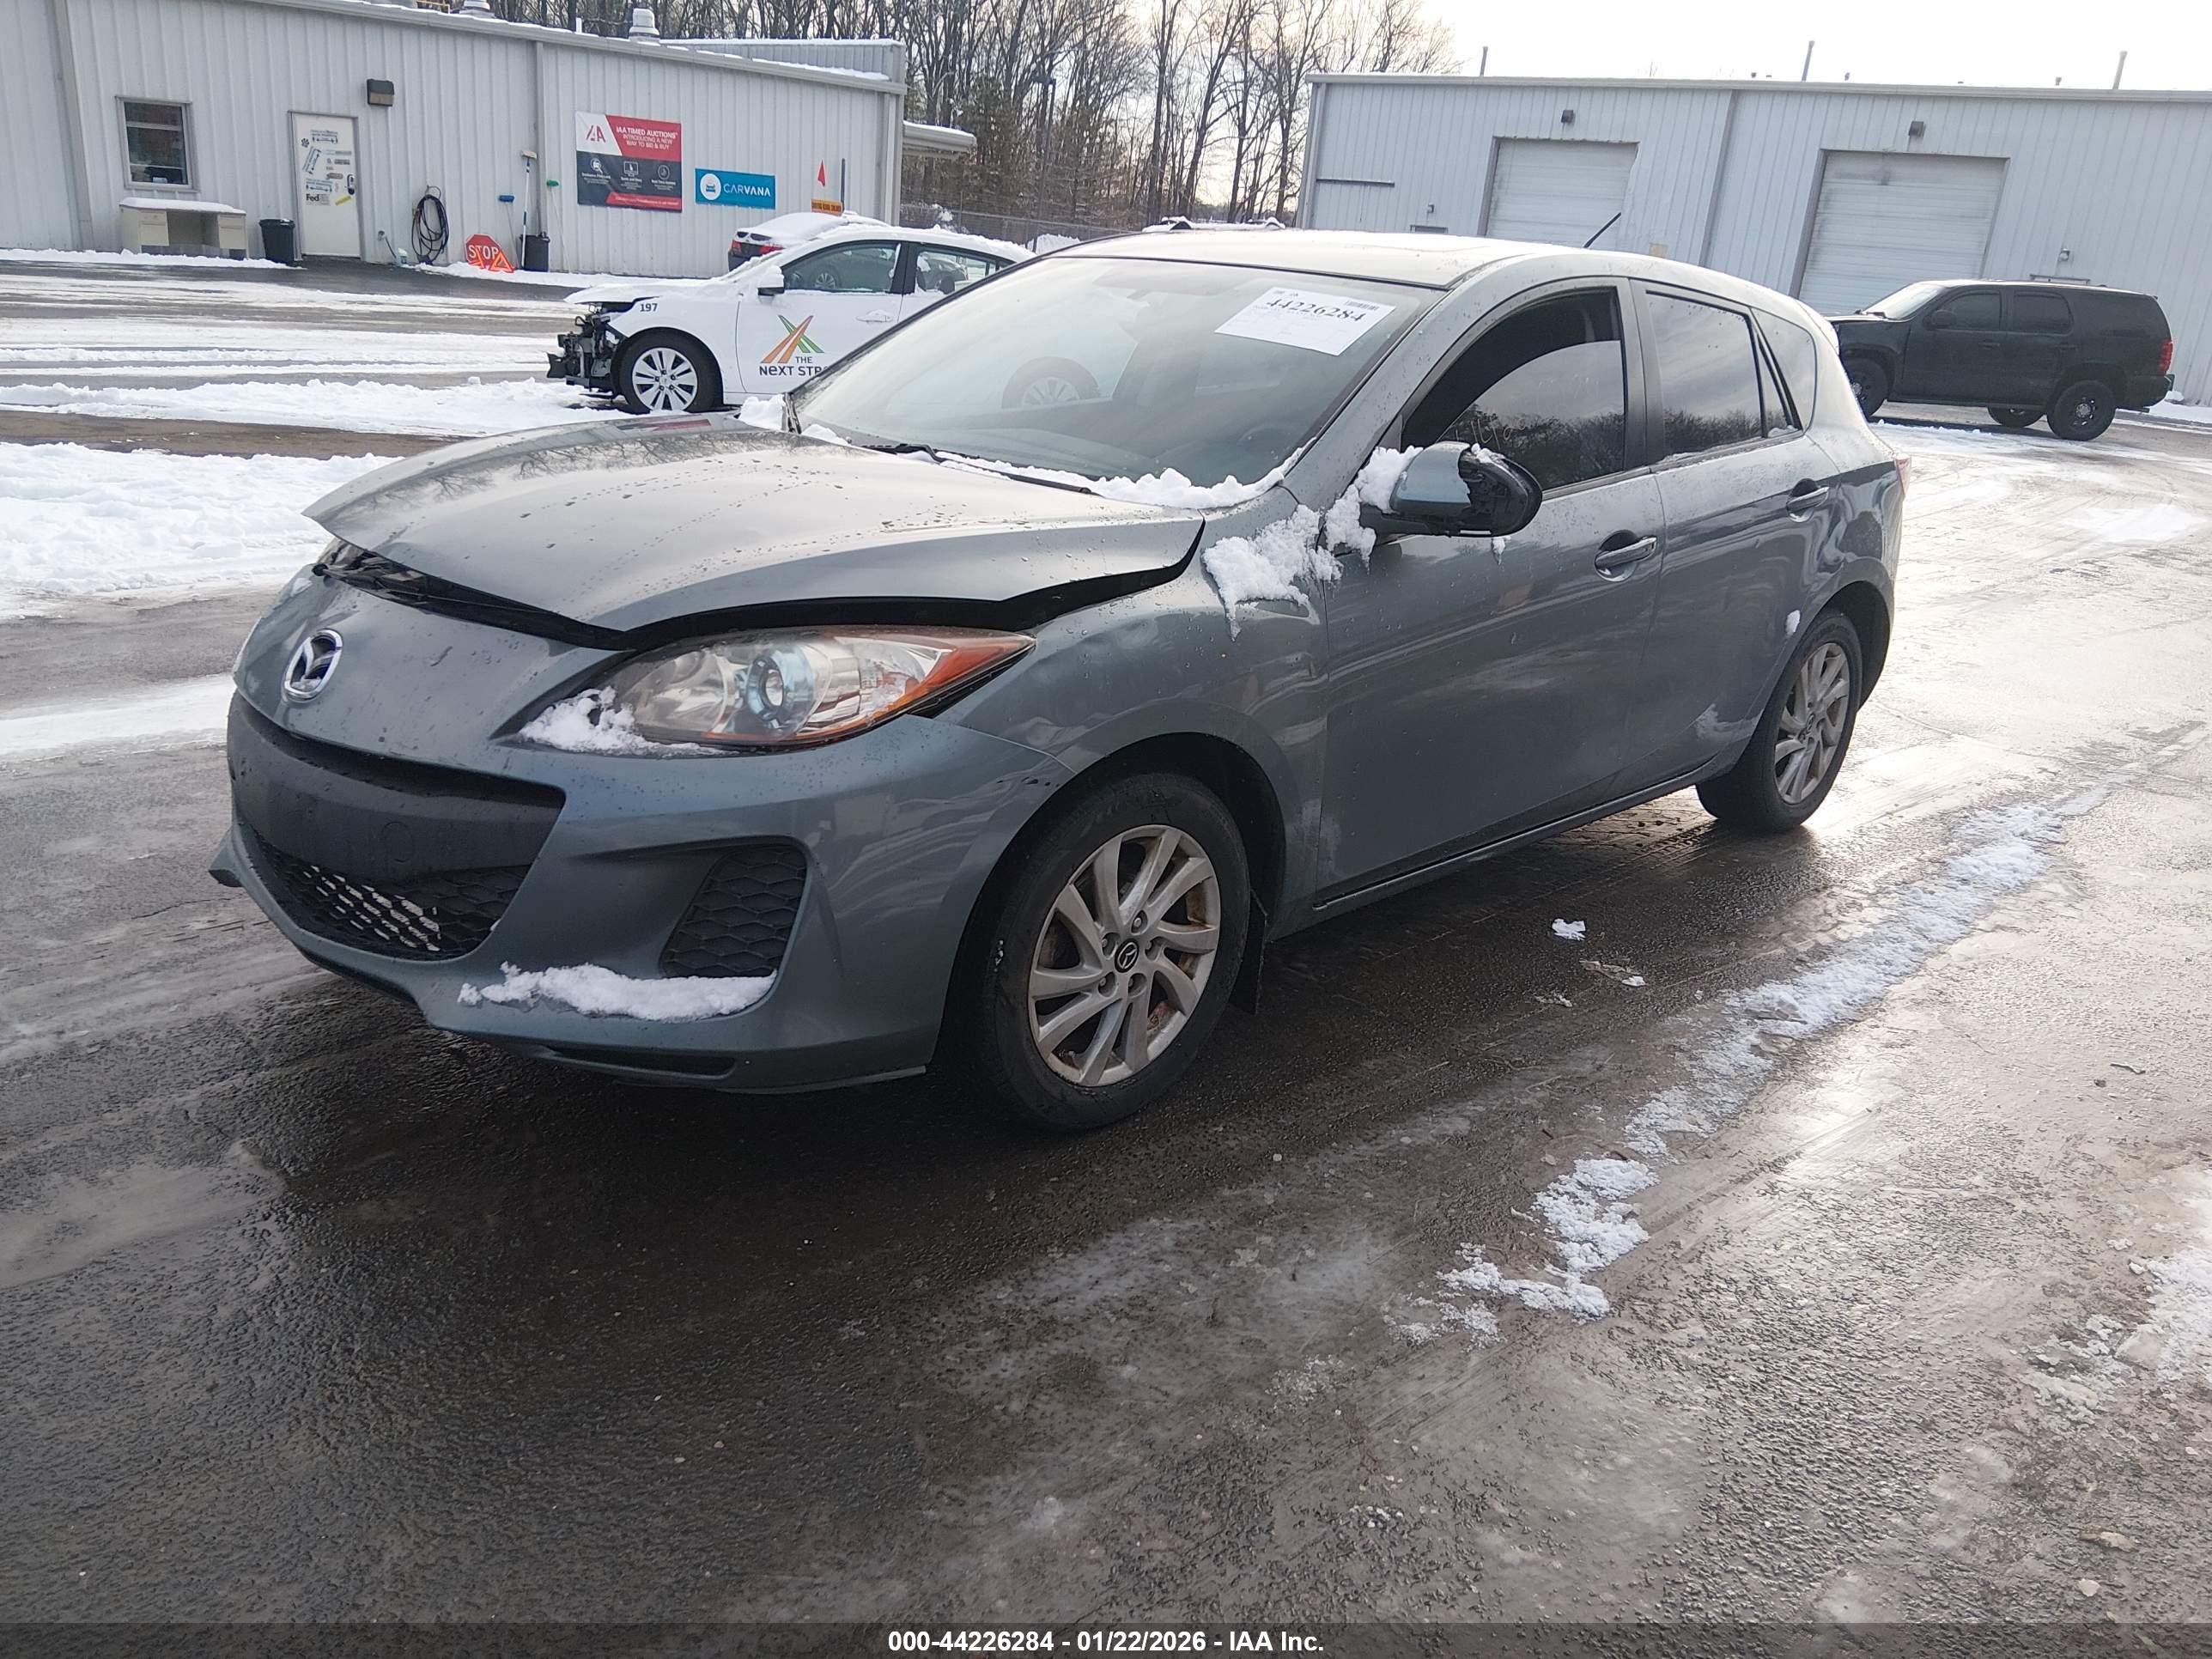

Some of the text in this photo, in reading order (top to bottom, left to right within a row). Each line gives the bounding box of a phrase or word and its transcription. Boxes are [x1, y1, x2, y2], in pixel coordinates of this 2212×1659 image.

[627, 127, 646, 136] TIMED
[623, 134, 656, 143] INTRODUCING
[723, 183, 771, 198] CARVANA
[468, 244, 499, 260] STOP
[639, 302, 659, 313] 197
[1266, 297, 1367, 323] 44226284
[795, 356, 813, 364] THE
[798, 365, 829, 376] STR
